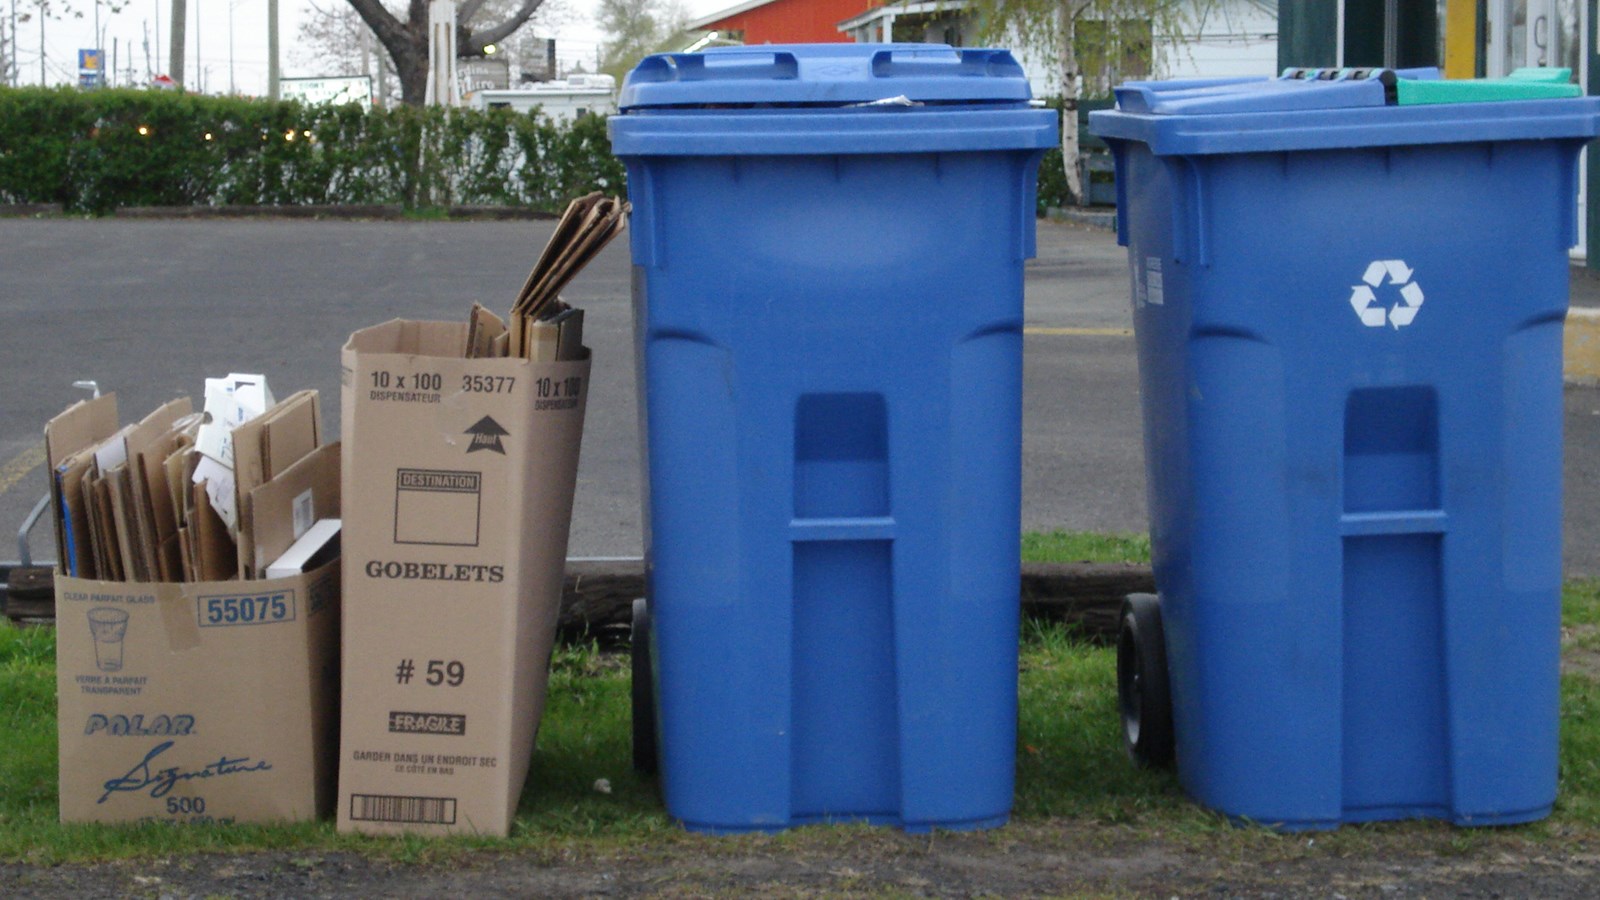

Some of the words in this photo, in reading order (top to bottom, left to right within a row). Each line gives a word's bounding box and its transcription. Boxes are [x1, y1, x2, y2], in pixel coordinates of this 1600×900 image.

[371, 371, 390, 388] 10
[396, 376, 405, 389] x
[413, 373, 442, 390] 100
[462, 375, 516, 393] 35377
[536, 377, 550, 398] 10
[370, 390, 441, 404] DISPENSATEUR
[475, 432, 497, 446] Haut
[403, 473, 475, 488] DESTINATION
[365, 560, 504, 583] GOBELETS
[208, 595, 287, 624] 55075
[395, 659, 415, 684] #
[426, 660, 465, 687] 59
[394, 714, 460, 733] FRAGILE
[353, 751, 391, 763] GARDER
[393, 752, 418, 764] DANS
[421, 754, 434, 764] UN
[437, 755, 476, 767] ENDROIT
[479, 757, 497, 768] SEC
[97, 741, 273, 804] Signature
[166, 797, 206, 814] 500
